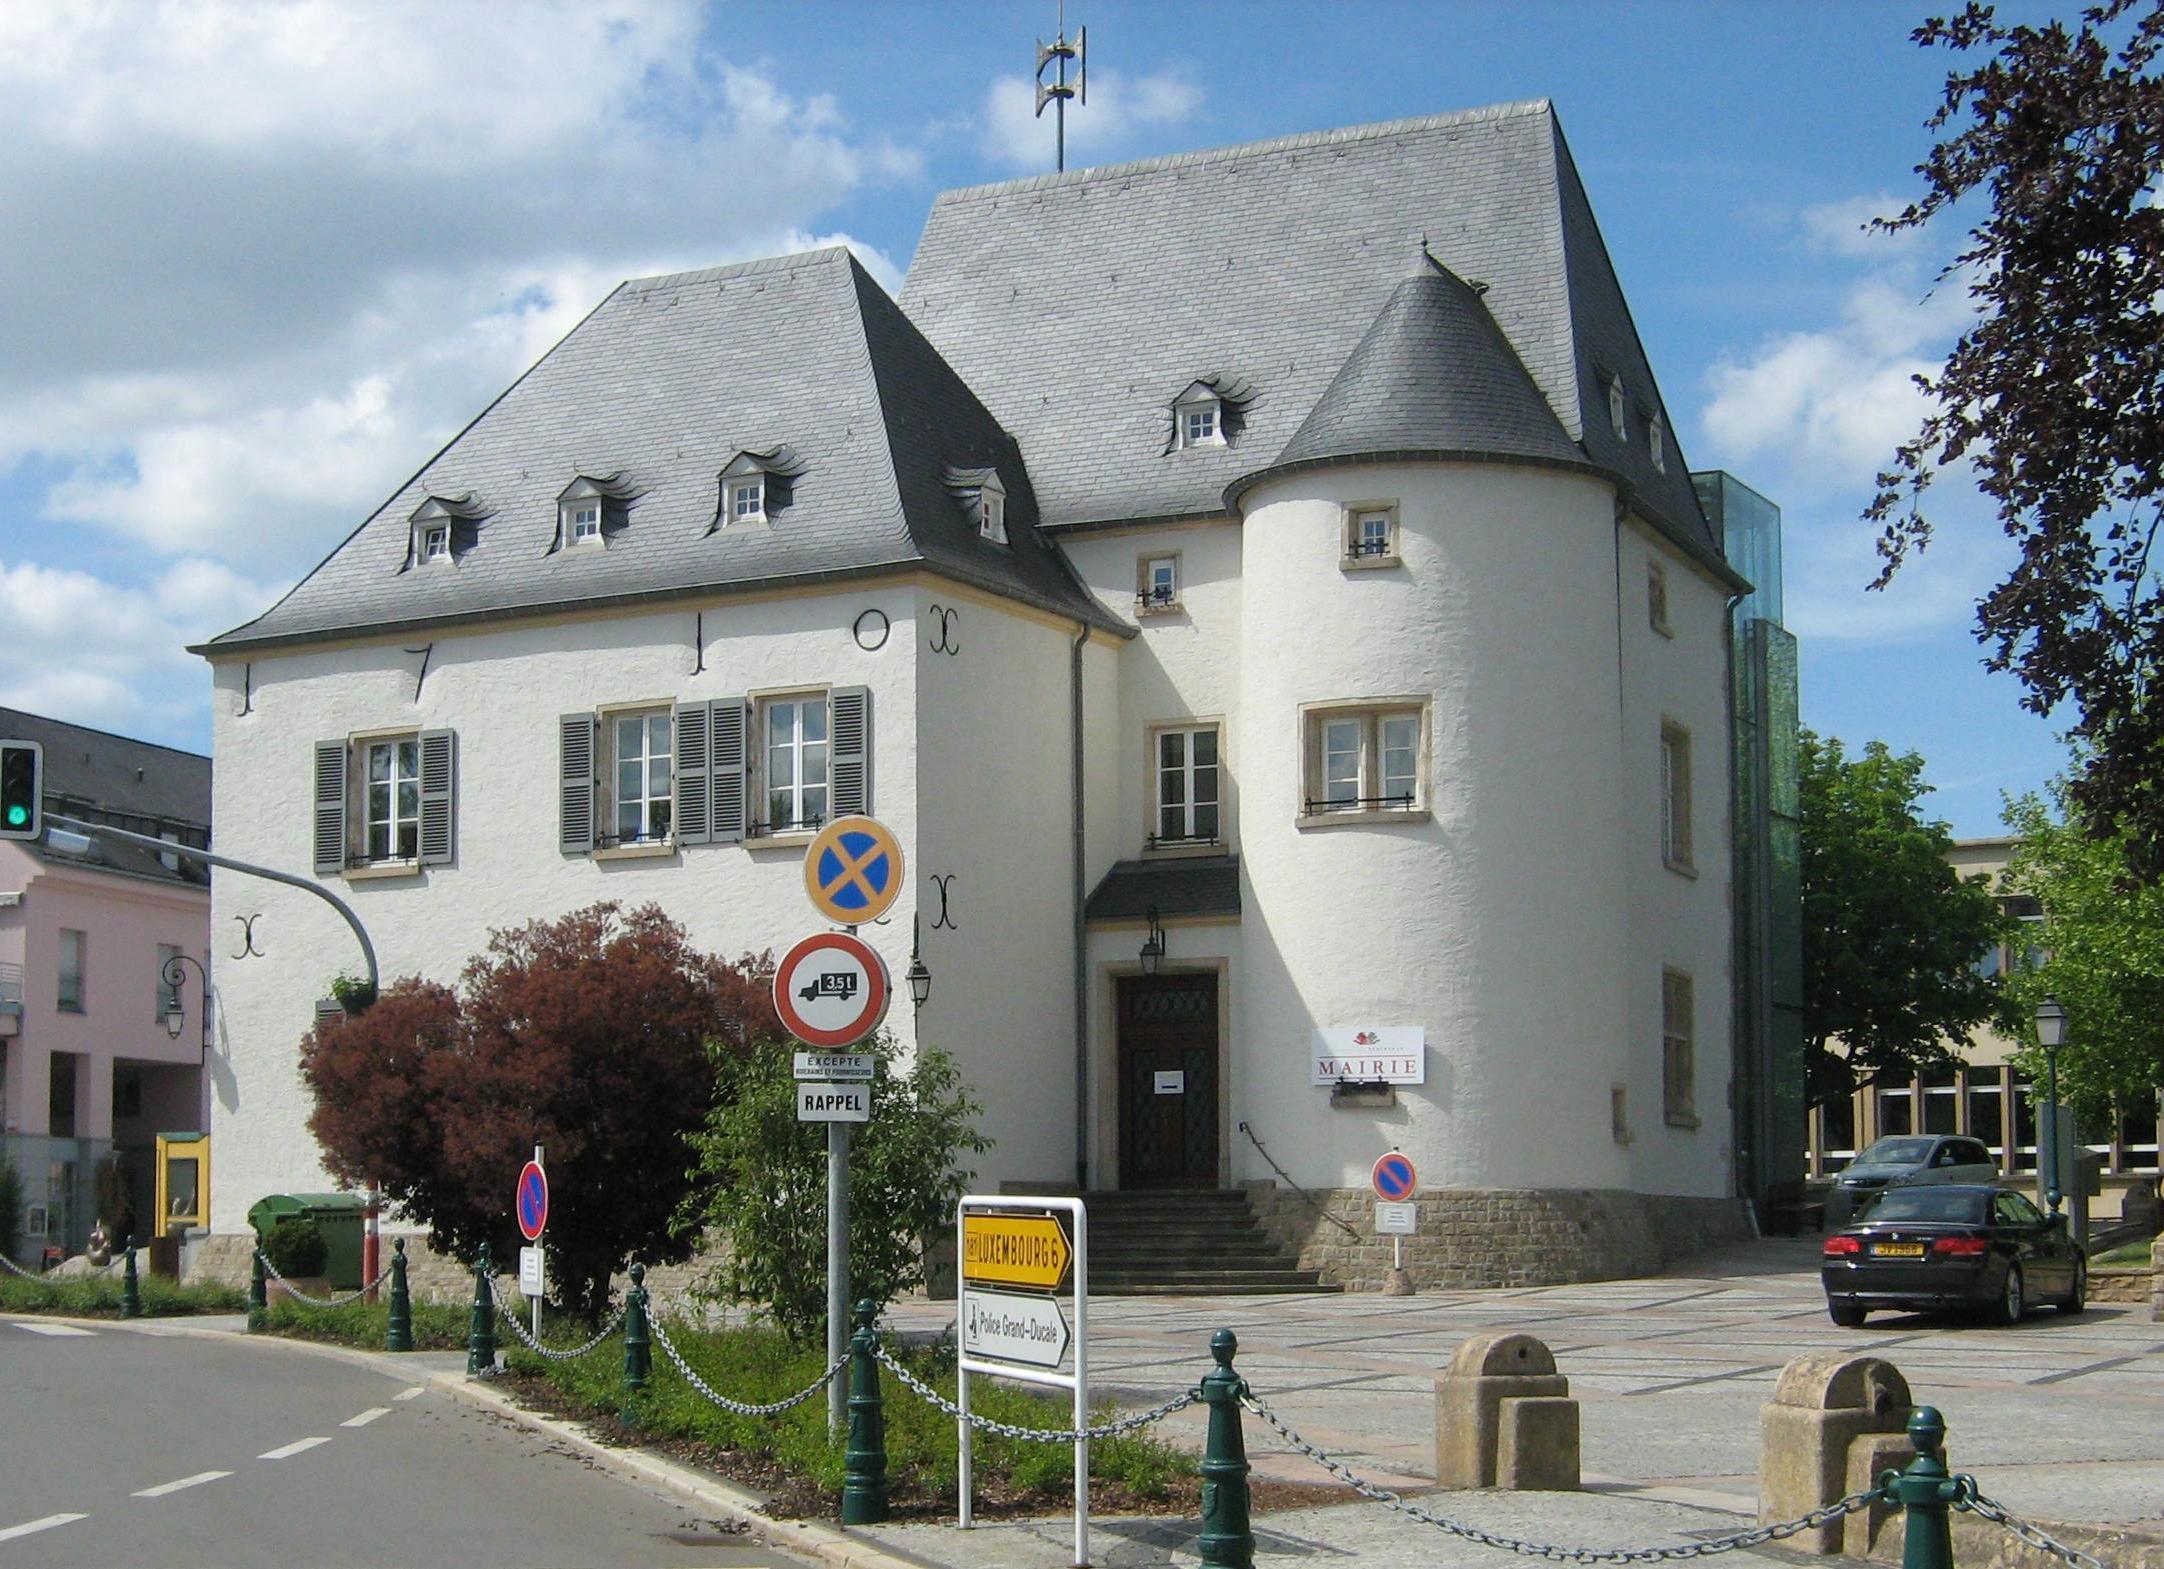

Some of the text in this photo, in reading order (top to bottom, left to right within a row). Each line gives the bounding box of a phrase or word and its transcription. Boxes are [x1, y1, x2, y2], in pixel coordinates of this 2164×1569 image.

[1318, 1060, 1417, 1075] MAIRIE
[805, 1095, 862, 1111] RAPPEL
[978, 1233, 1059, 1269] LUXEMBOURG 6
[980, 1311, 1058, 1344] Police Grand-Ducale
